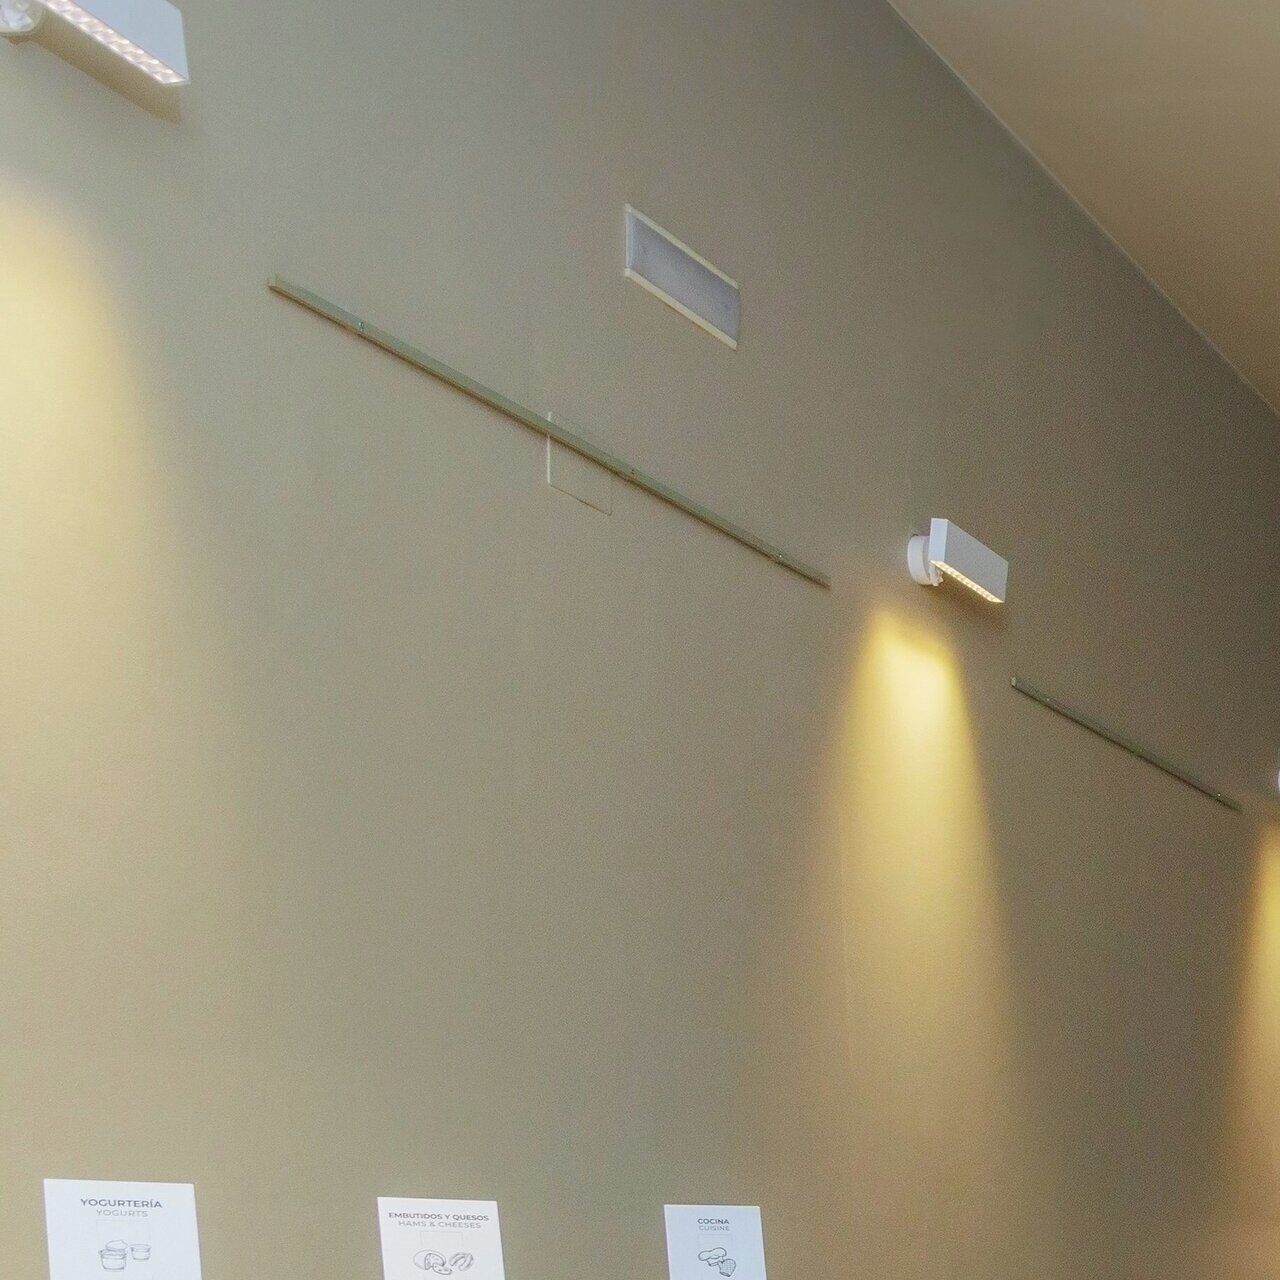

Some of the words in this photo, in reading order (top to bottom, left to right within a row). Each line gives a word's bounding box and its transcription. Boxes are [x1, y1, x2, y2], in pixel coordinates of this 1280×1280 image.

[80, 1198, 163, 1208] YOGURTERÍA
[96, 1209, 148, 1217] YOGURTS
[388, 1212, 443, 1220] EMBUTIDOS
[452, 1214, 489, 1222] QUESOS
[438, 1221, 481, 1229] CHEESES
